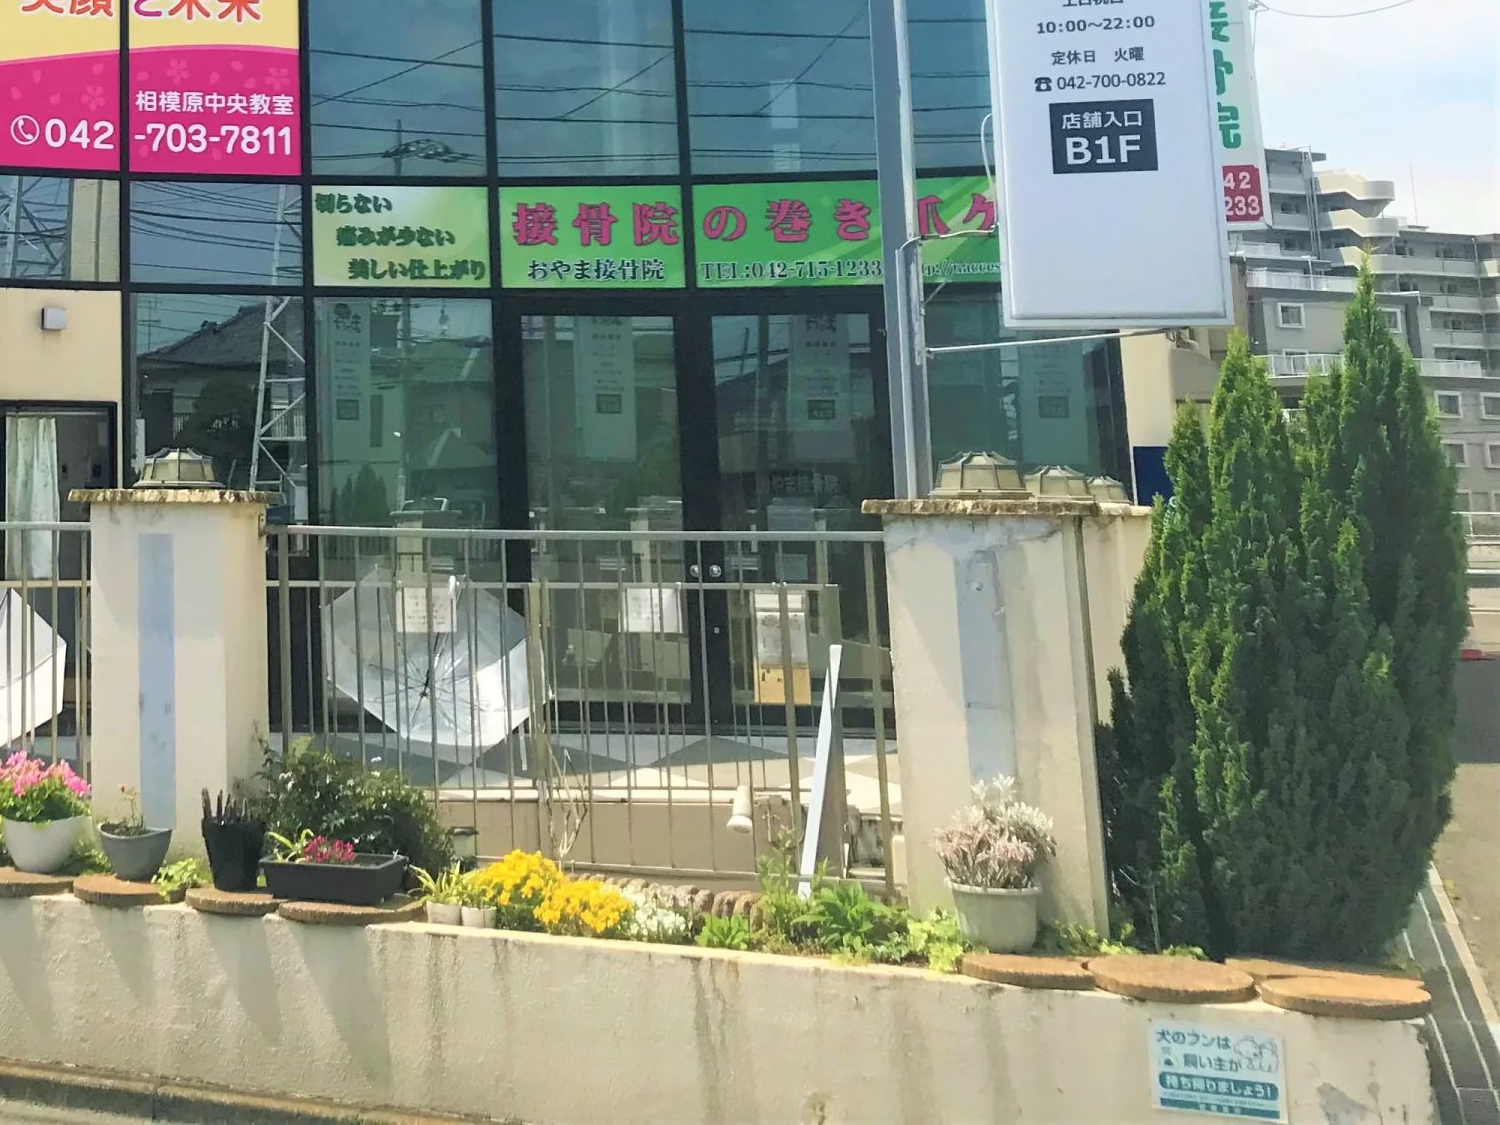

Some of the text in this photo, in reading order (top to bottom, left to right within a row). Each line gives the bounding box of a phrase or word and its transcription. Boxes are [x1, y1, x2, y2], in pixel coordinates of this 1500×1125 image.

[1051, 46, 1145, 66] 定休日 火曜
[1056, 71, 1166, 91] 042-700-0822
[136, 92, 295, 117] 相模原中央教室
[1061, 110, 1143, 130] 店舗入口
[45, 119, 293, 156] 042 -703-7811
[1065, 134, 1141, 166] B1F
[315, 193, 393, 214] 切らない
[512, 201, 680, 247] 接骨院
[336, 226, 456, 247] 痛みが少ない
[348, 258, 486, 280] 美しい仕上がり
[527, 258, 665, 280] おやま接骨院
[1156, 1028, 1232, 1050] 犬のフンは
[1183, 1053, 1243, 1072] 飼い主が
